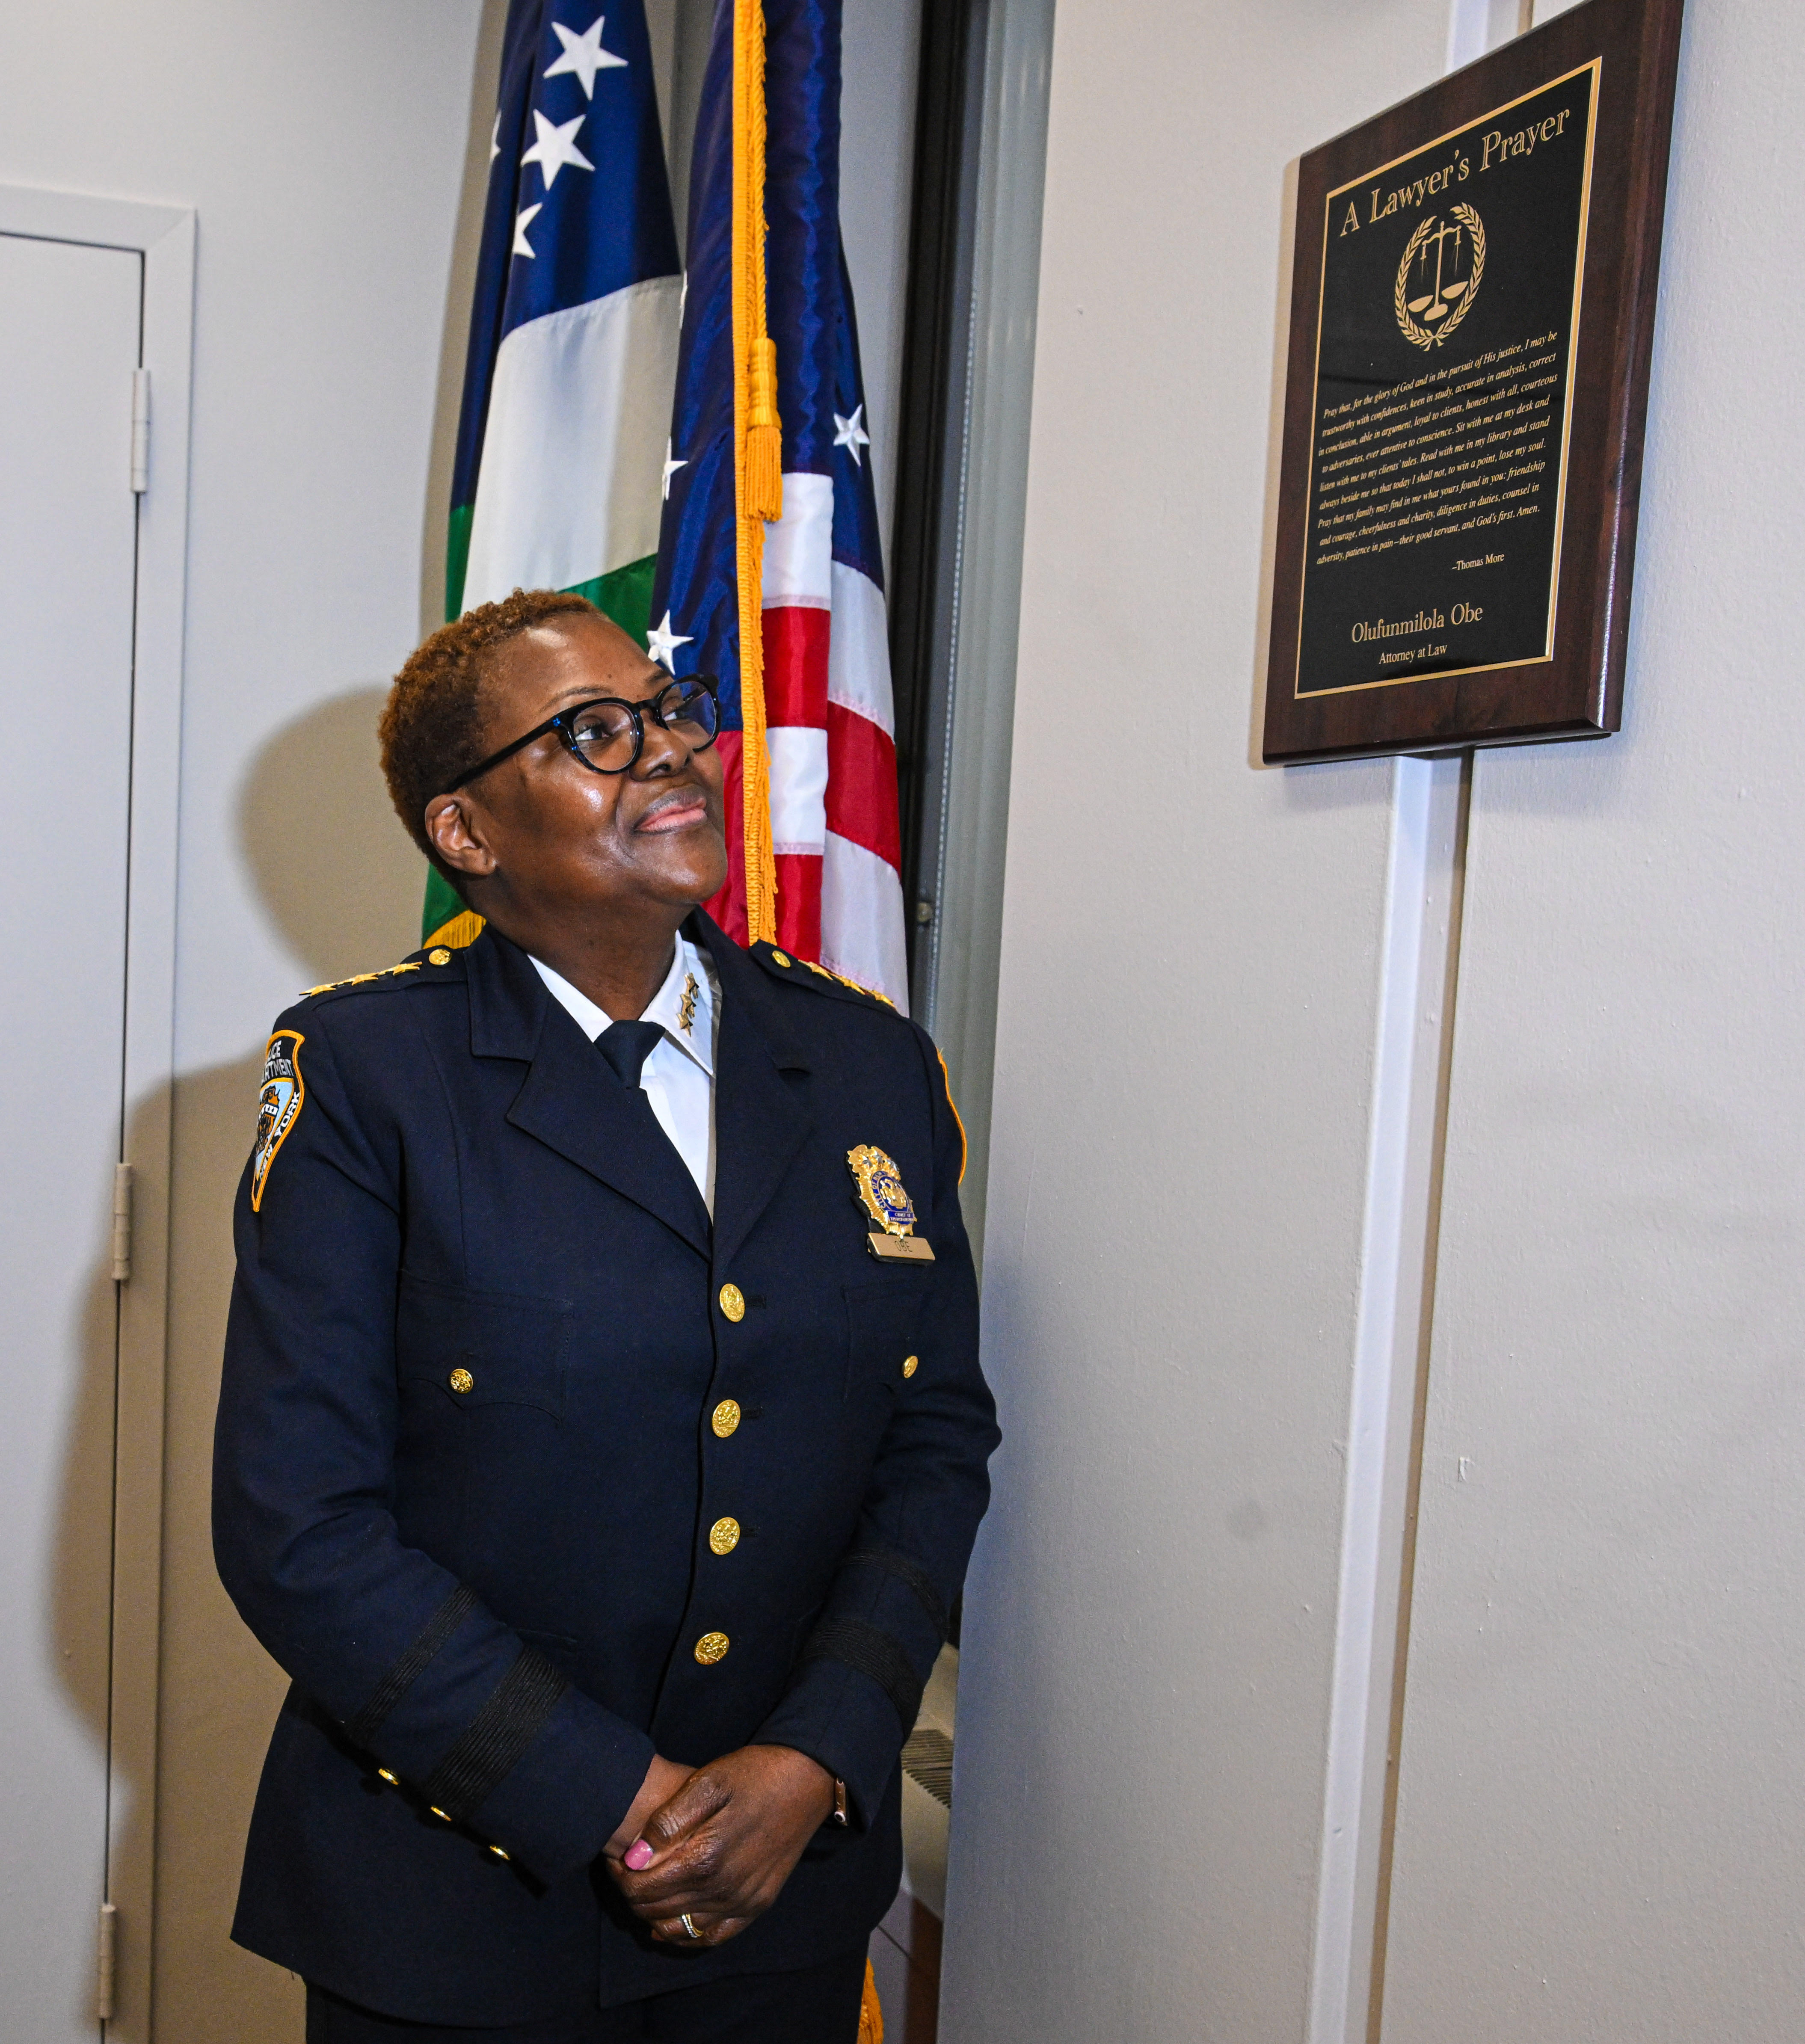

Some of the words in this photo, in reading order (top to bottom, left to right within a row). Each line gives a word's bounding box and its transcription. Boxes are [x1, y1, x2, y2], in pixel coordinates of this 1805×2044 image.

[1340, 201, 1360, 237] A
[1479, 109, 1570, 172] Prayer
[1322, 419, 1356, 437] trustworthy
[1356, 413, 1369, 426] with
[1370, 403, 1408, 421] confidences,
[1410, 397, 1425, 408] keen
[1426, 393, 1433, 403] in
[1434, 386, 1454, 400] study,
[1455, 377, 1485, 394] accurate
[1487, 373, 1494, 383] in
[1495, 362, 1527, 380] analysis,
[1529, 353, 1556, 369] correct
[1323, 408, 1338, 419] Pray
[1352, 398, 1363, 411] for
[1363, 394, 1374, 405] the
[1374, 390, 1391, 404] glory
[1392, 384, 1400, 397] of
[1399, 378, 1415, 392] God
[1415, 374, 1429, 388] and
[1429, 373, 1436, 383] in
[1437, 369, 1448, 380] the
[1448, 359, 1474, 379] pursuit
[1474, 355, 1484, 369] of
[1483, 352, 1496, 364] His
[1496, 344, 1523, 362] justice,
[1525, 338, 1529, 350] I
[1530, 336, 1547, 348] may
[1547, 330, 1558, 342] be
[1318, 447, 1325, 456] in
[1374, 430, 1381, 439] in
[1414, 412, 1432, 427] loyal
[1432, 412, 1439, 421] to
[1440, 405, 1464, 418] clients,
[1465, 395, 1489, 410] honest
[1490, 388, 1506, 402] with
[1507, 383, 1519, 397] all,
[1520, 374, 1558, 392] courteous
[1365, 450, 1380, 460] ever
[1380, 441, 1408, 456] attentive
[1408, 439, 1415, 447] to
[1416, 427, 1454, 444] conscience.
[1455, 421, 1466, 433] Sit
[1467, 416, 1482, 429] with
[1482, 415, 1494, 424] me
[1495, 411, 1503, 421] at
[1504, 408, 1516, 419] my
[1516, 400, 1534, 415] desk
[1535, 394, 1550, 409] and
[1319, 482, 1335, 492] listen
[1337, 475, 1349, 486] with
[1350, 474, 1360, 483] me
[1368, 469, 1378, 479] my
[1402, 456, 1419, 468] tales.
[1420, 448, 1438, 463] Read
[1438, 444, 1453, 457] with
[1454, 444, 1465, 453] me
[1466, 439, 1473, 450] in
[1475, 437, 1486, 448] my
[1487, 430, 1512, 444] library
[1513, 422, 1528, 436] and
[1528, 415, 1550, 432] stand
[1319, 498, 1340, 510] always
[1340, 491, 1360, 504] beside
[1360, 490, 1370, 498] me
[1371, 488, 1379, 496] so
[1379, 483, 1392, 493] that
[1393, 477, 1411, 490] today
[1412, 474, 1416, 485] I
[1416, 469, 1433, 483] shall
[1434, 468, 1446, 478] not,
[1448, 466, 1455, 474] to
[1457, 460, 1470, 471] win
[1470, 460, 1476, 468] a
[1476, 454, 1497, 469] point,
[1499, 450, 1514, 460] lose
[1515, 446, 1527, 457] my
[1527, 438, 1546, 452] soul.
[1318, 519, 1332, 529] Pray
[1333, 514, 1345, 524] that
[1345, 513, 1355, 522] my
[1354, 505, 1375, 521] family
[1375, 504, 1390, 513] may
[1388, 497, 1403, 512] find
[1403, 496, 1411, 506] in
[1411, 495, 1422, 504] me
[1423, 489, 1440, 500] what
[1439, 485, 1459, 499] yours
[1458, 476, 1482, 494] found
[1481, 475, 1489, 485] in
[1490, 472, 1507, 486] you:
[1506, 460, 1545, 481] friendship
[1319, 534, 1332, 546] and
[1331, 530, 1357, 543] courage,
[1358, 520, 1396, 536] cheerfulness
[1397, 514, 1411, 526] and
[1411, 510, 1435, 523] charity,
[1436, 502, 1468, 517] diligence
[1468, 498, 1476, 509] in
[1477, 493, 1501, 506] duties,
[1502, 483, 1531, 500] counsel
[1532, 482, 1540, 492] in
[1317, 551, 1344, 565] adversity,
[1345, 546, 1371, 560] patience
[1372, 542, 1378, 551] in
[1415, 527, 1433, 544] good
[1433, 523, 1460, 537] servant,
[1461, 517, 1476, 530] and
[1497, 510, 1515, 524] first.
[1516, 505, 1540, 517] Amen.
[1485, 553, 1505, 565] More
[1352, 608, 1445, 643] Olufunmilola
[1451, 602, 1483, 625] Obe
[1378, 650, 1416, 664] Attorney
[1417, 647, 1426, 658] at
[1427, 644, 1447, 657] Law
[274, 1091, 300, 1138] YORK
[895, 1240, 913, 1252] OBE
